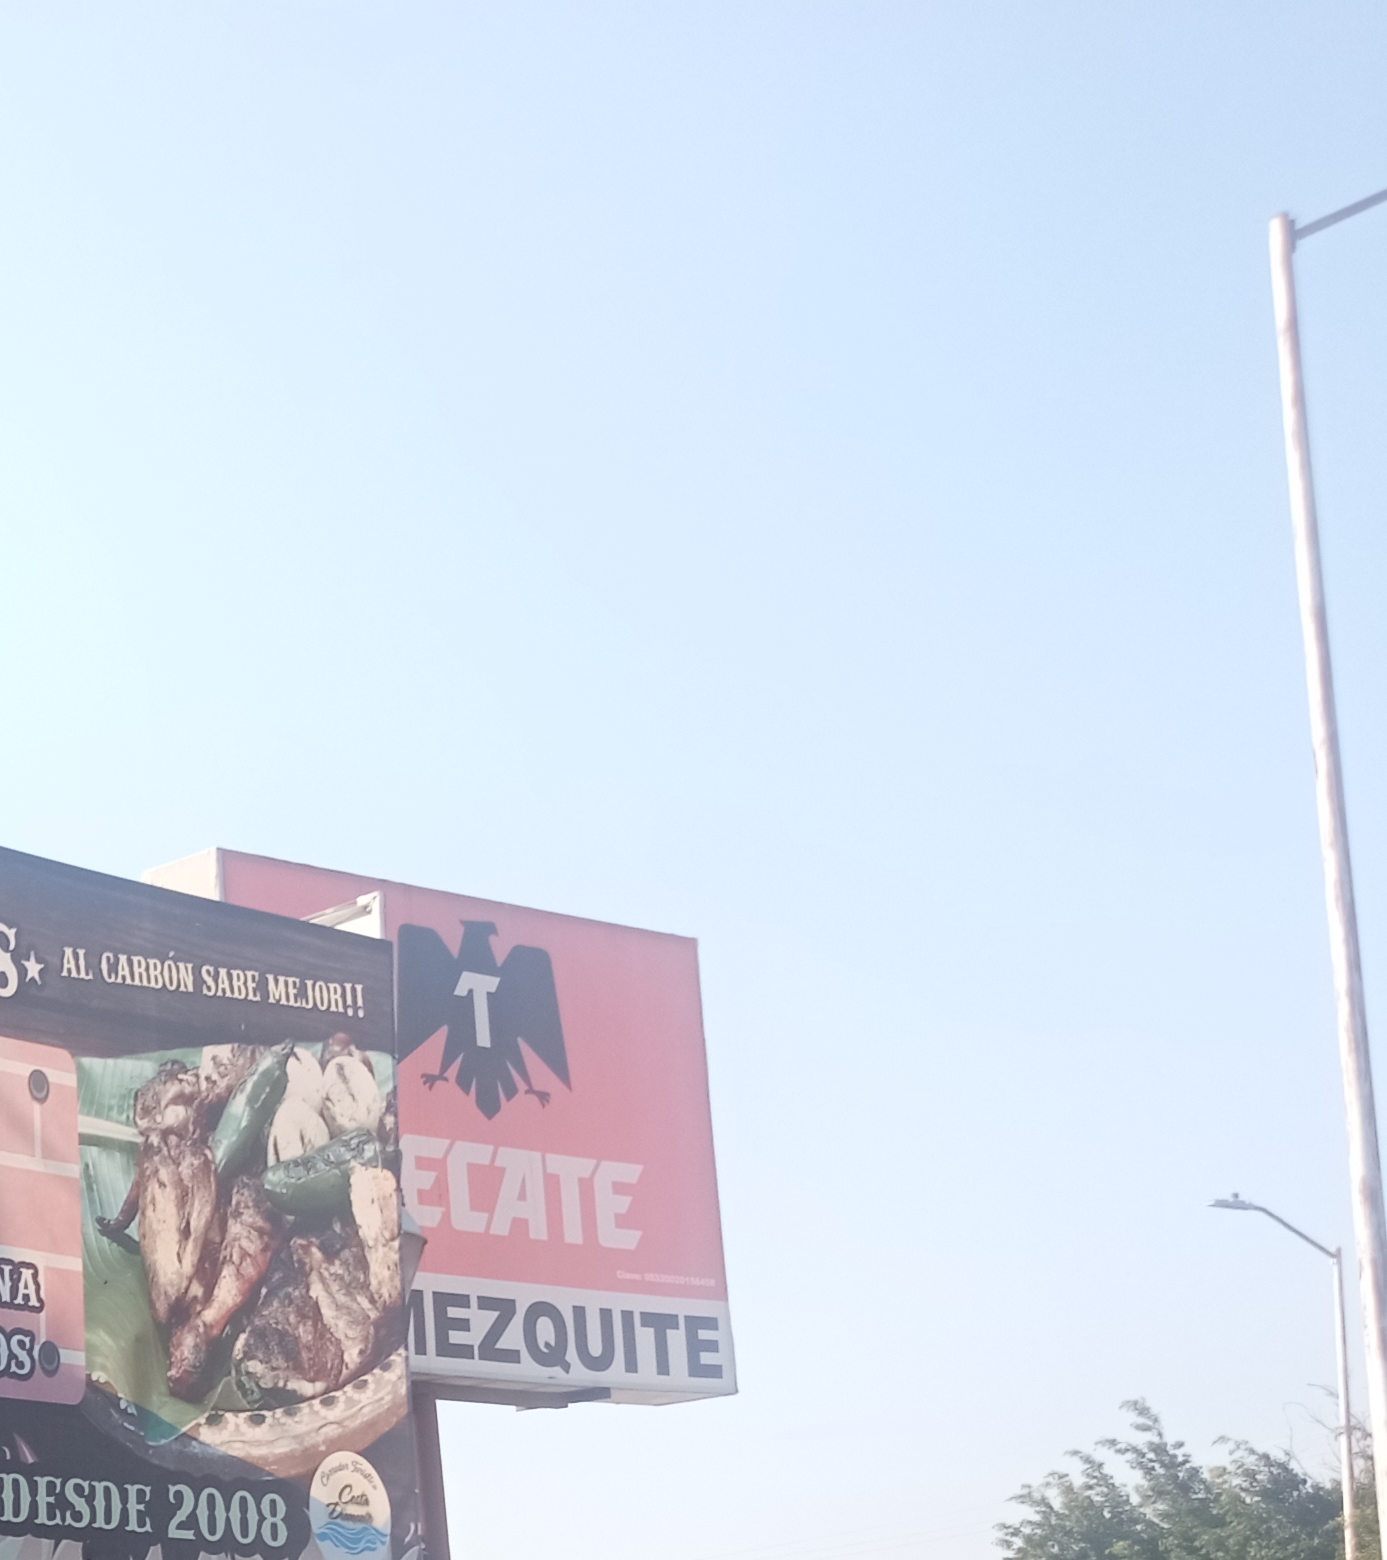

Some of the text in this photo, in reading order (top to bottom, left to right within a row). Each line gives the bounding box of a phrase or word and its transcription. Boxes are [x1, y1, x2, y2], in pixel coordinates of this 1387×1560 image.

[61, 946, 365, 1018] AL CARBÓN SABE MEJOR!!
[399, 1133, 644, 1250] ECATE
[0, 1472, 153, 1534] DESDE
[166, 1483, 288, 1547] 2008
